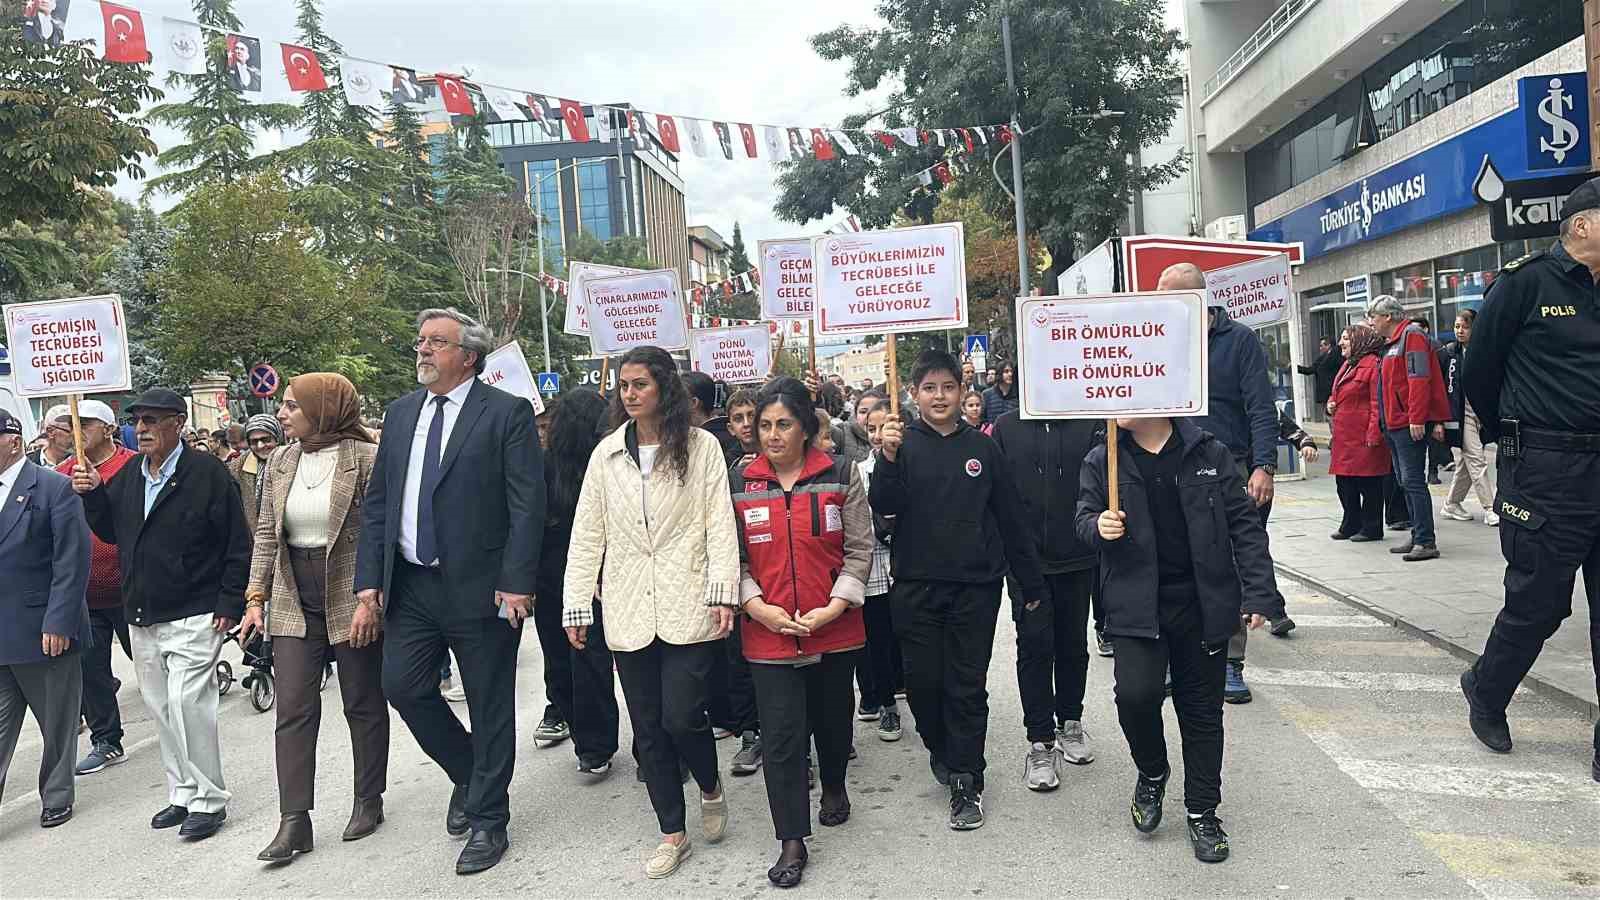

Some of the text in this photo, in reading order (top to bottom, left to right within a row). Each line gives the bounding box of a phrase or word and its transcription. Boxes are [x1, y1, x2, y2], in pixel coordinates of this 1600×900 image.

[1320, 201, 1361, 234] TÜRKİYE
[1372, 173, 1426, 215] BANKASI
[831, 245, 945, 266] BÜYÜKLERİMİZİN
[780, 258, 812, 272] GEÇM
[841, 263, 935, 281] TECRÜBESİ İLE
[777, 287, 813, 298] GELEC
[855, 280, 923, 297] GELECEĞE
[1212, 287, 1232, 300] YAŞ
[1233, 283, 1248, 294] DA
[1250, 274, 1279, 290] SEVGİ
[595, 289, 668, 307] ÇINARLARIMIZIN
[849, 297, 931, 314] YÜRÜYORUZ
[1227, 299, 1283, 320] KLANAMAZ
[31, 317, 97, 337] GEÇMİŞİN
[613, 317, 657, 329] GELECEĞE
[1051, 320, 1166, 341] BİR ÖMÜRLÜK
[30, 332, 102, 352] TECRÜBESİ
[617, 330, 657, 342] GÜVENLE
[31, 350, 103, 368] GELECEĞİN
[1083, 346, 1133, 359] EMEK,
[43, 368, 96, 386] IŞIĞIDIR
[1052, 361, 1166, 380] BİR ÖMÜRLÜK
[1085, 385, 1132, 399] SAYGI
